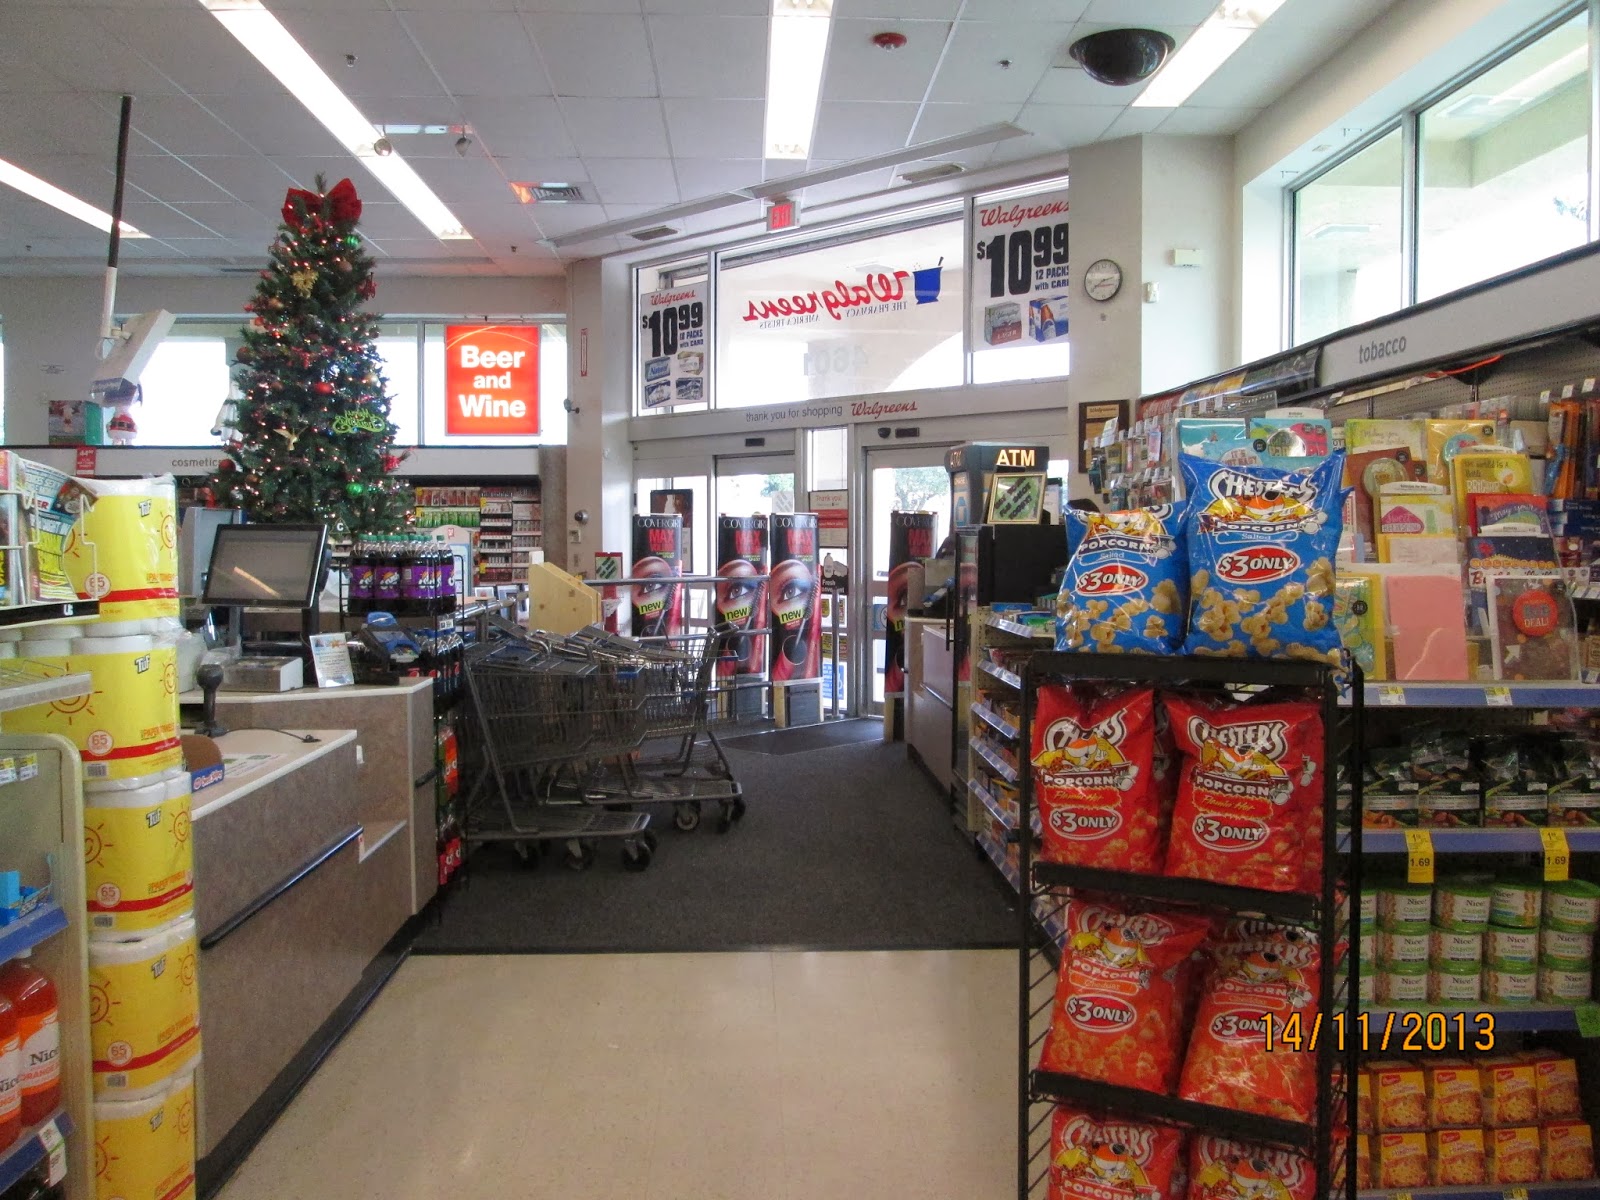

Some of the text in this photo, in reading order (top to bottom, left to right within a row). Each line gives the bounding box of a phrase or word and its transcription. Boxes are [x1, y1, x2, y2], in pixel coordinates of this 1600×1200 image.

[771, 203, 793, 229] EXIT
[980, 201, 1069, 228] Walgreens
[1035, 269, 1044, 280] 12
[1051, 278, 1069, 289] CAR
[651, 290, 696, 306] Walgreens
[460, 345, 526, 369] Beer
[1358, 335, 1407, 364] tobacco
[473, 371, 511, 389] and
[458, 394, 526, 418] Wine
[746, 400, 918, 422] thank you for shopping Walgreens
[996, 449, 1035, 466] ATM
[648, 528, 674, 543] MAX
[1216, 521, 1298, 533] POPCORN
[1241, 532, 1272, 540] Salted
[1079, 538, 1151, 552] POPCORN
[1220, 555, 1294, 577] $3 ONLY
[1079, 571, 1142, 591] $3 ONLY
[640, 600, 662, 614] new
[726, 606, 748, 620] new
[780, 608, 802, 624] new
[91, 734, 108, 746] 65
[1044, 775, 1113, 787] POPCORN
[1196, 776, 1270, 796] POPCORN
[1053, 811, 1116, 832] $3 ONLY
[1195, 819, 1264, 842] $3 ONLY
[1410, 857, 1430, 867] 1.69
[1546, 855, 1566, 865] 1.69
[101, 886, 116, 897] 65
[1072, 959, 1140, 979] POPCORN
[1067, 999, 1132, 1023] $3 ONLY
[1213, 1015, 1239, 1035] $3
